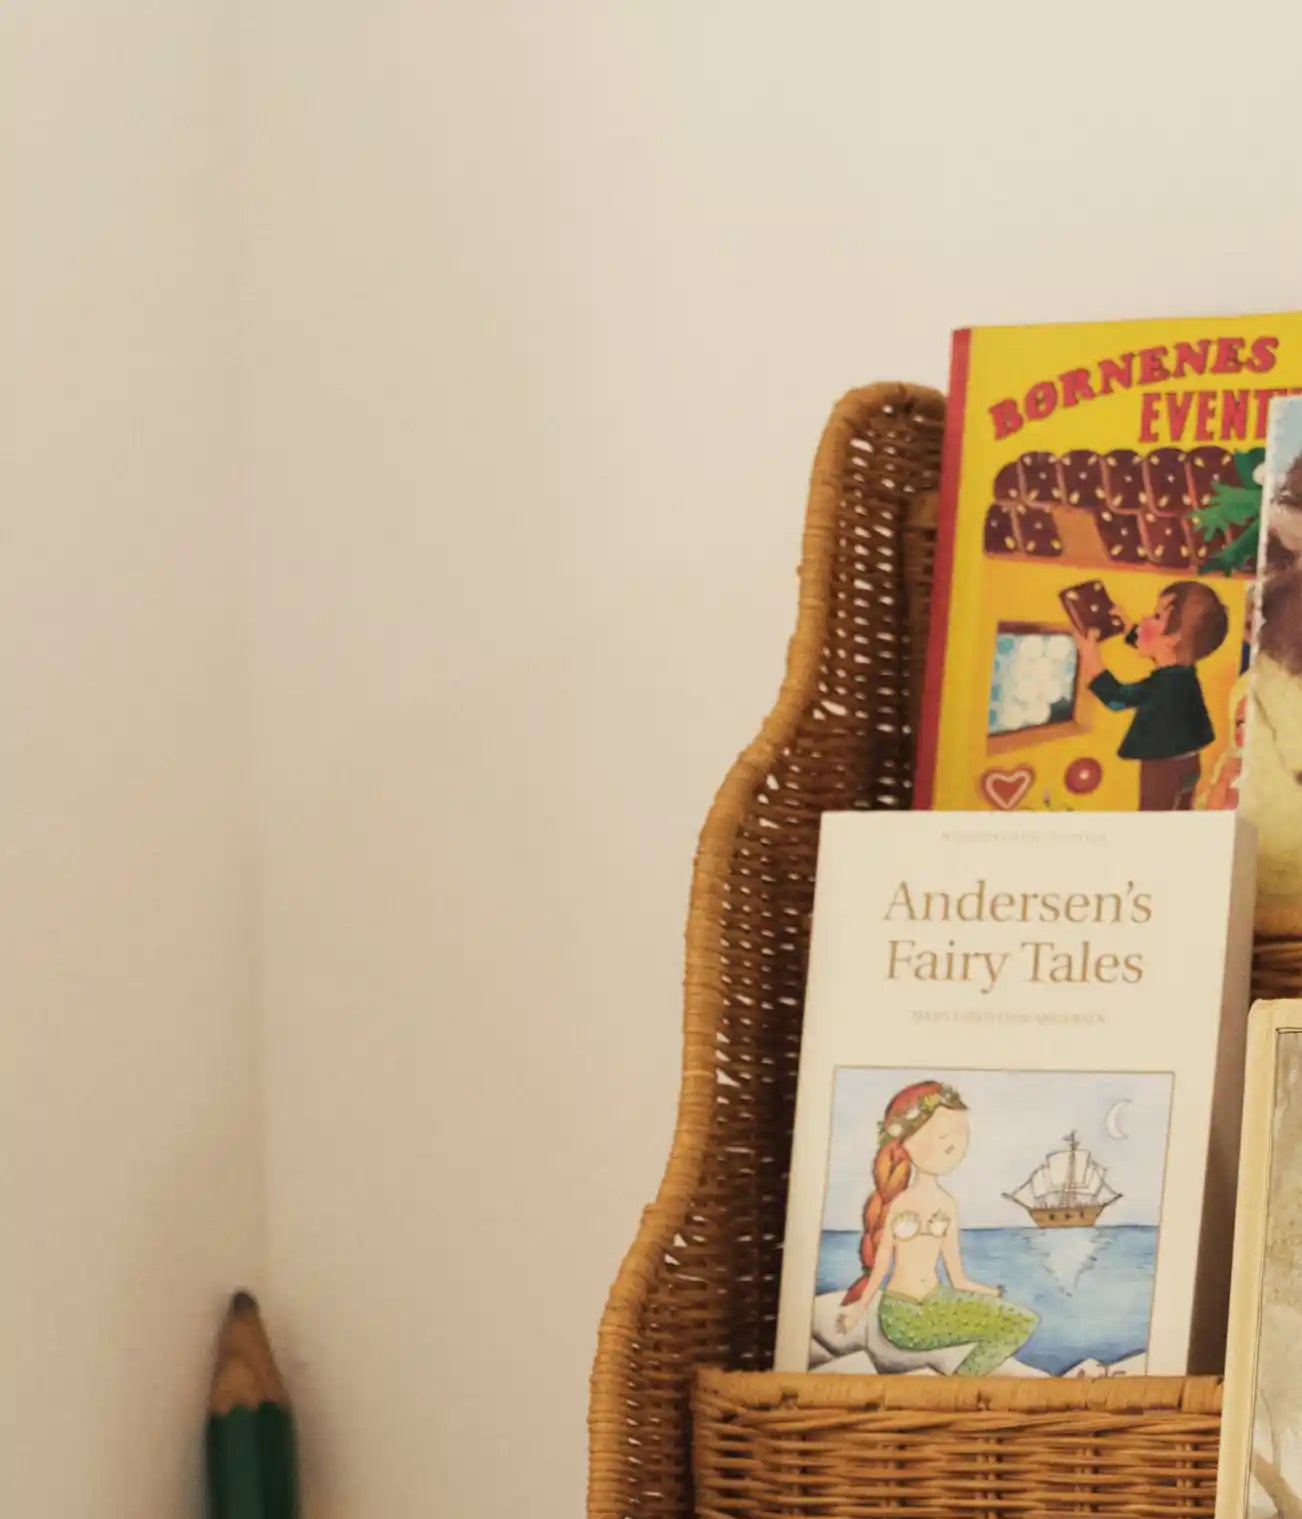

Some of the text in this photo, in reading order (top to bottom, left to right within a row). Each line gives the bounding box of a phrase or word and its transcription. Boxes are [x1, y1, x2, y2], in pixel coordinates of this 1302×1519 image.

[987, 335, 1280, 440] BØRNENES
[881, 878, 1153, 925] Andersen's
[886, 939, 1145, 995] Fairy Tales
